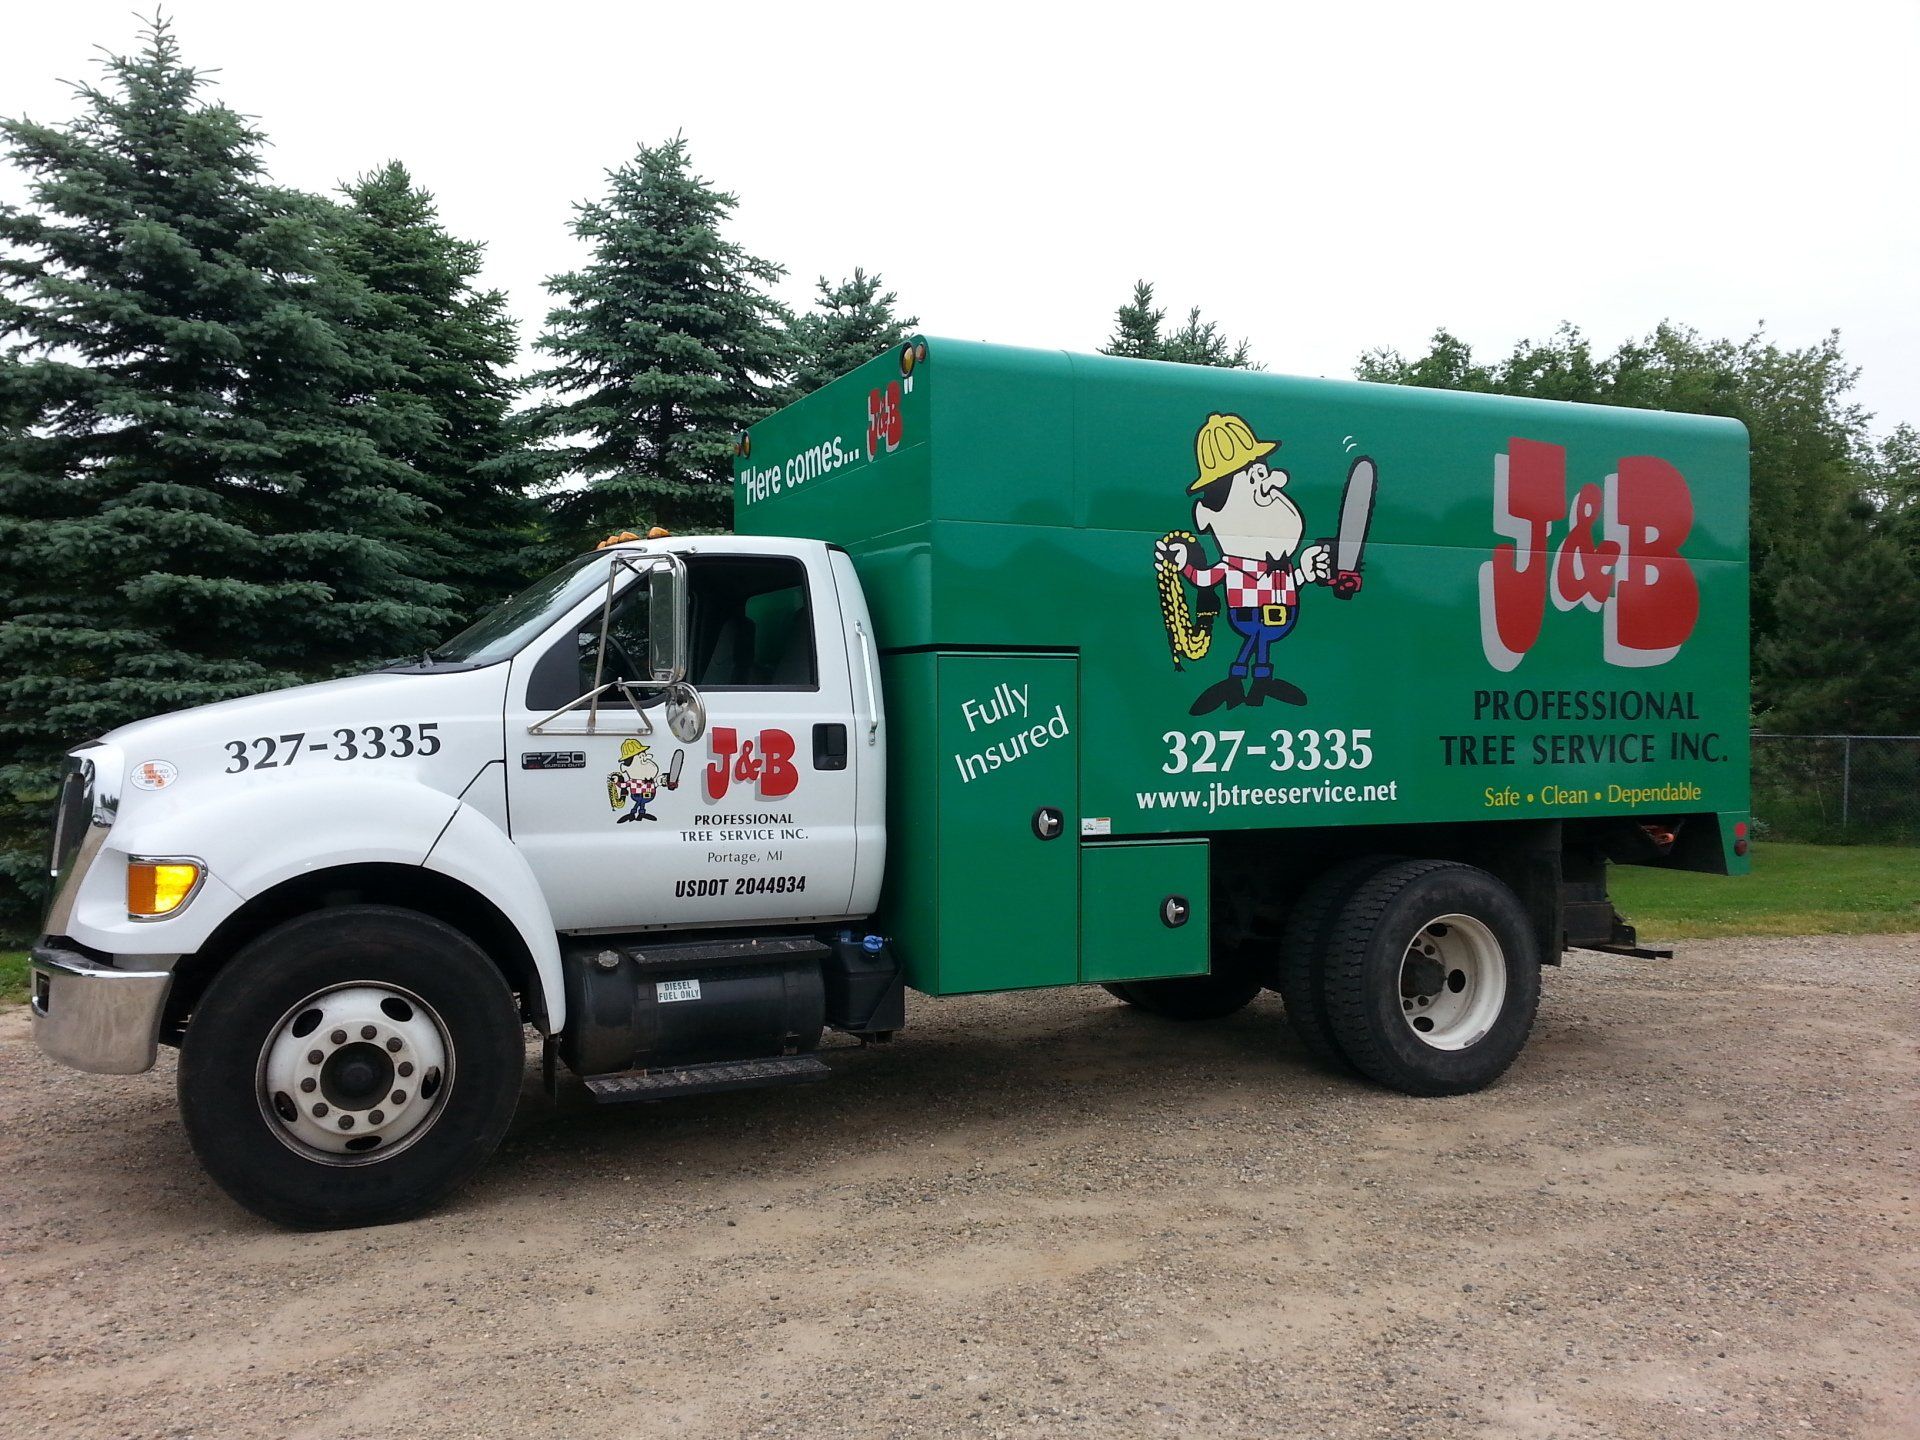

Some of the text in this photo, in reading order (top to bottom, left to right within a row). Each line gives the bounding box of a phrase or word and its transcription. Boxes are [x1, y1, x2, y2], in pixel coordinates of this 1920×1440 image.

[786, 436, 860, 488] comes...
[1478, 437, 1700, 672] J&B
[961, 682, 1028, 732] Fully
[1473, 689, 1700, 721] PROFESSIONAL
[225, 723, 441, 774] 327-3335
[954, 704, 1070, 783] Insured
[1162, 729, 1373, 774] 327-3335
[1439, 732, 1728, 766] TREE SERVICE INC.
[701, 727, 799, 805] J&B
[1136, 779, 1397, 813] www.jbtreeservice.net
[1484, 782, 1702, 808] Safe Clean Dependable
[680, 828, 809, 841] TREE SERVICE INC.
[694, 813, 794, 825] PROFESSIONAL
[707, 850, 783, 865] Portage, MI
[675, 875, 806, 897] USDOT 2044934
[659, 989, 699, 1001] FUEL ONLY
[664, 981, 691, 991] DIESEL
